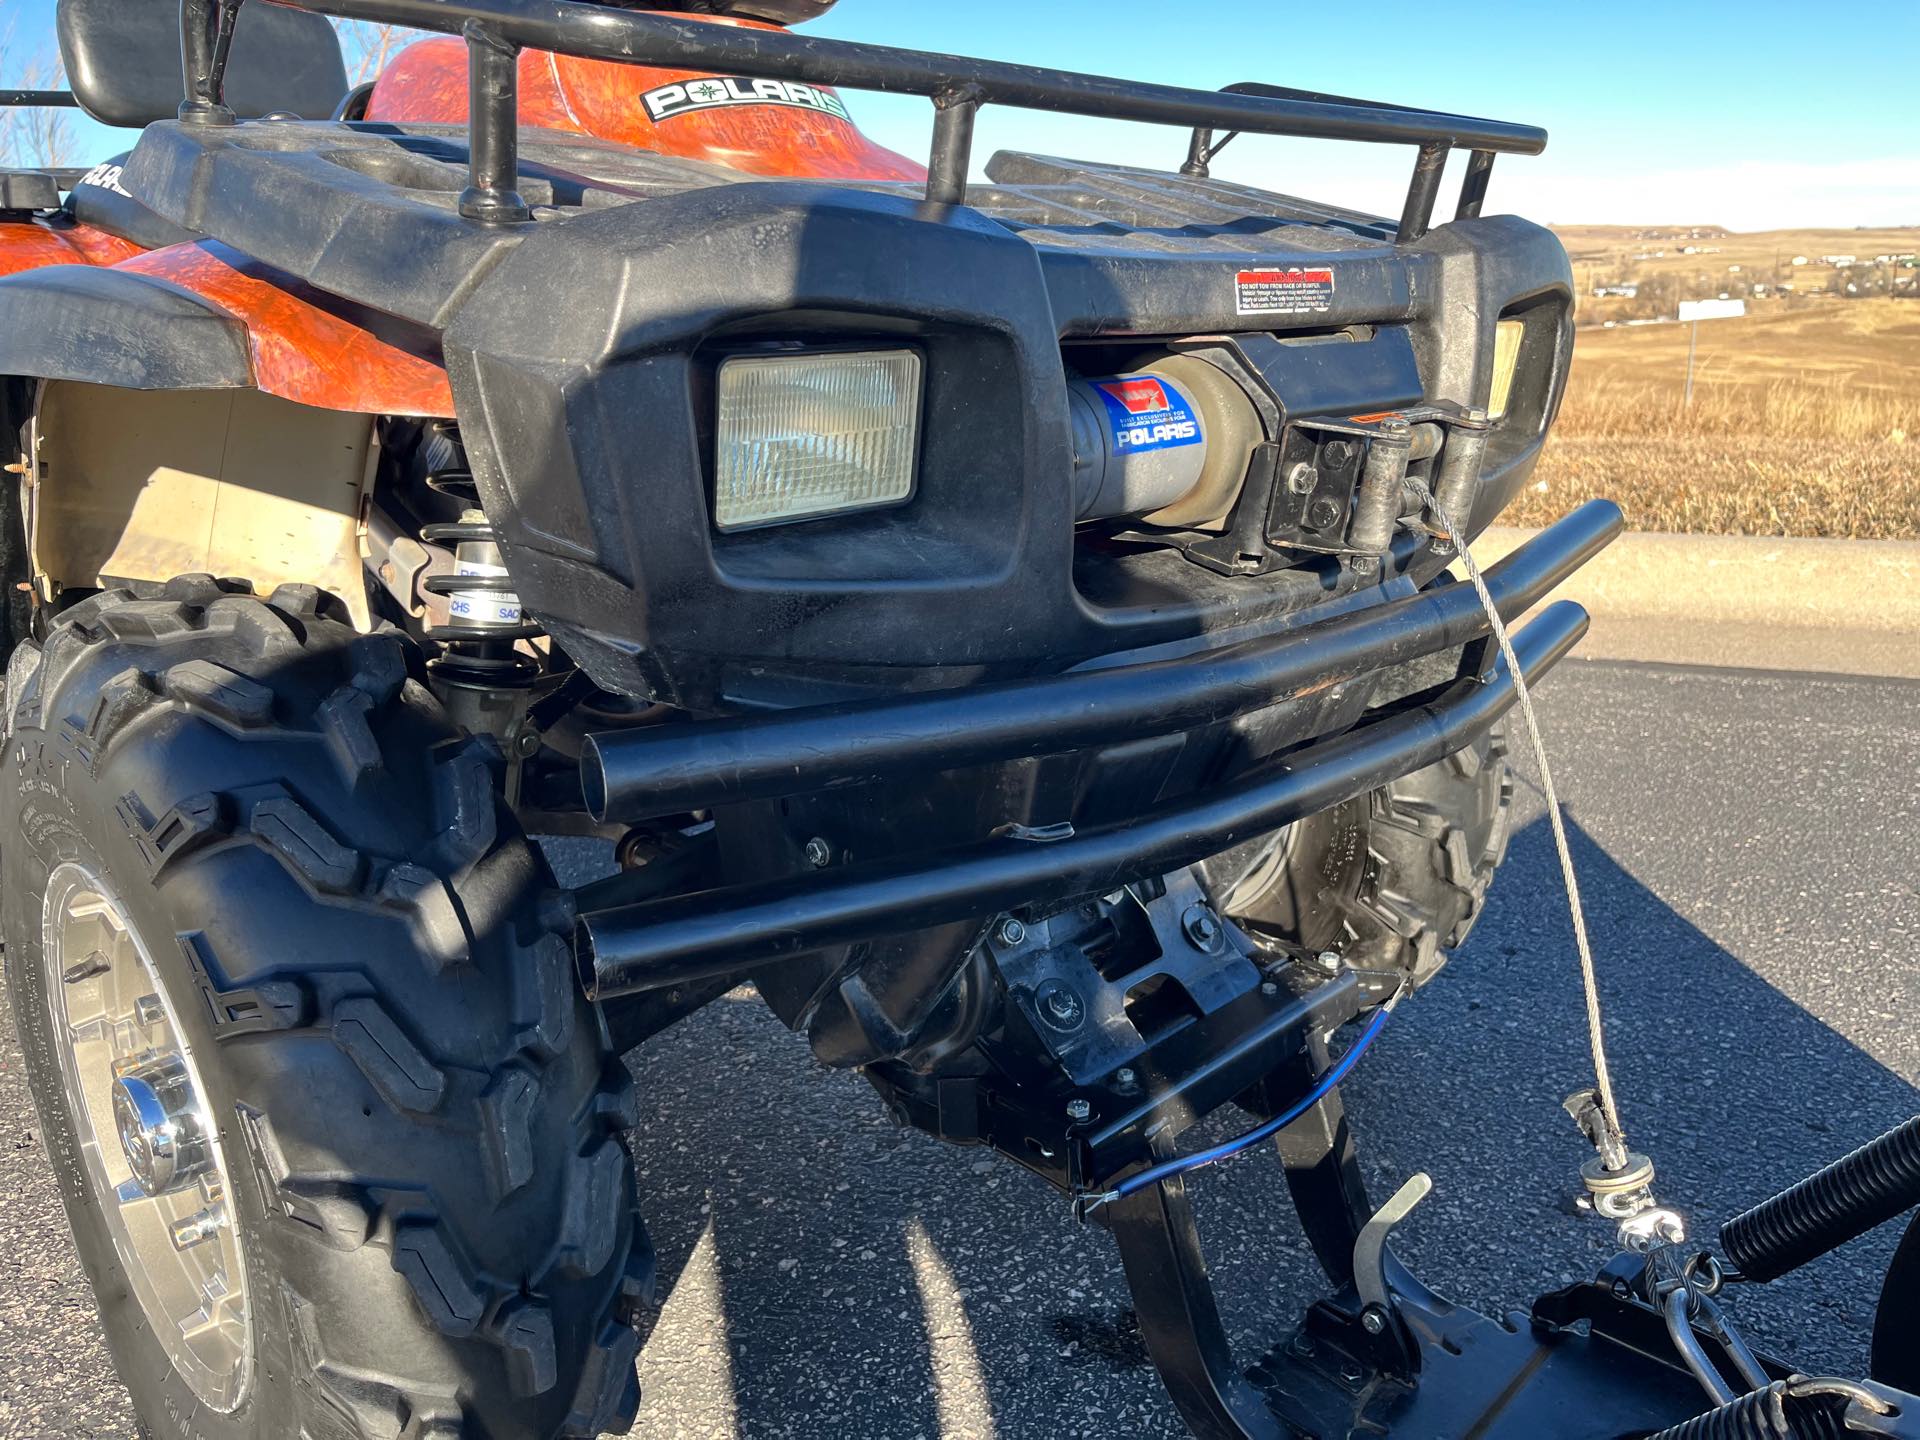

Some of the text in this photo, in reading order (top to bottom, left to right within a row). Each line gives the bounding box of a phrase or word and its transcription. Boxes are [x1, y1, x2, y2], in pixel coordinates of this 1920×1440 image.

[644, 78, 849, 117] POLARIS
[79, 163, 133, 198] POLAR
[1117, 421, 1196, 447] POLARIS
[499, 608, 521, 619] SAC
